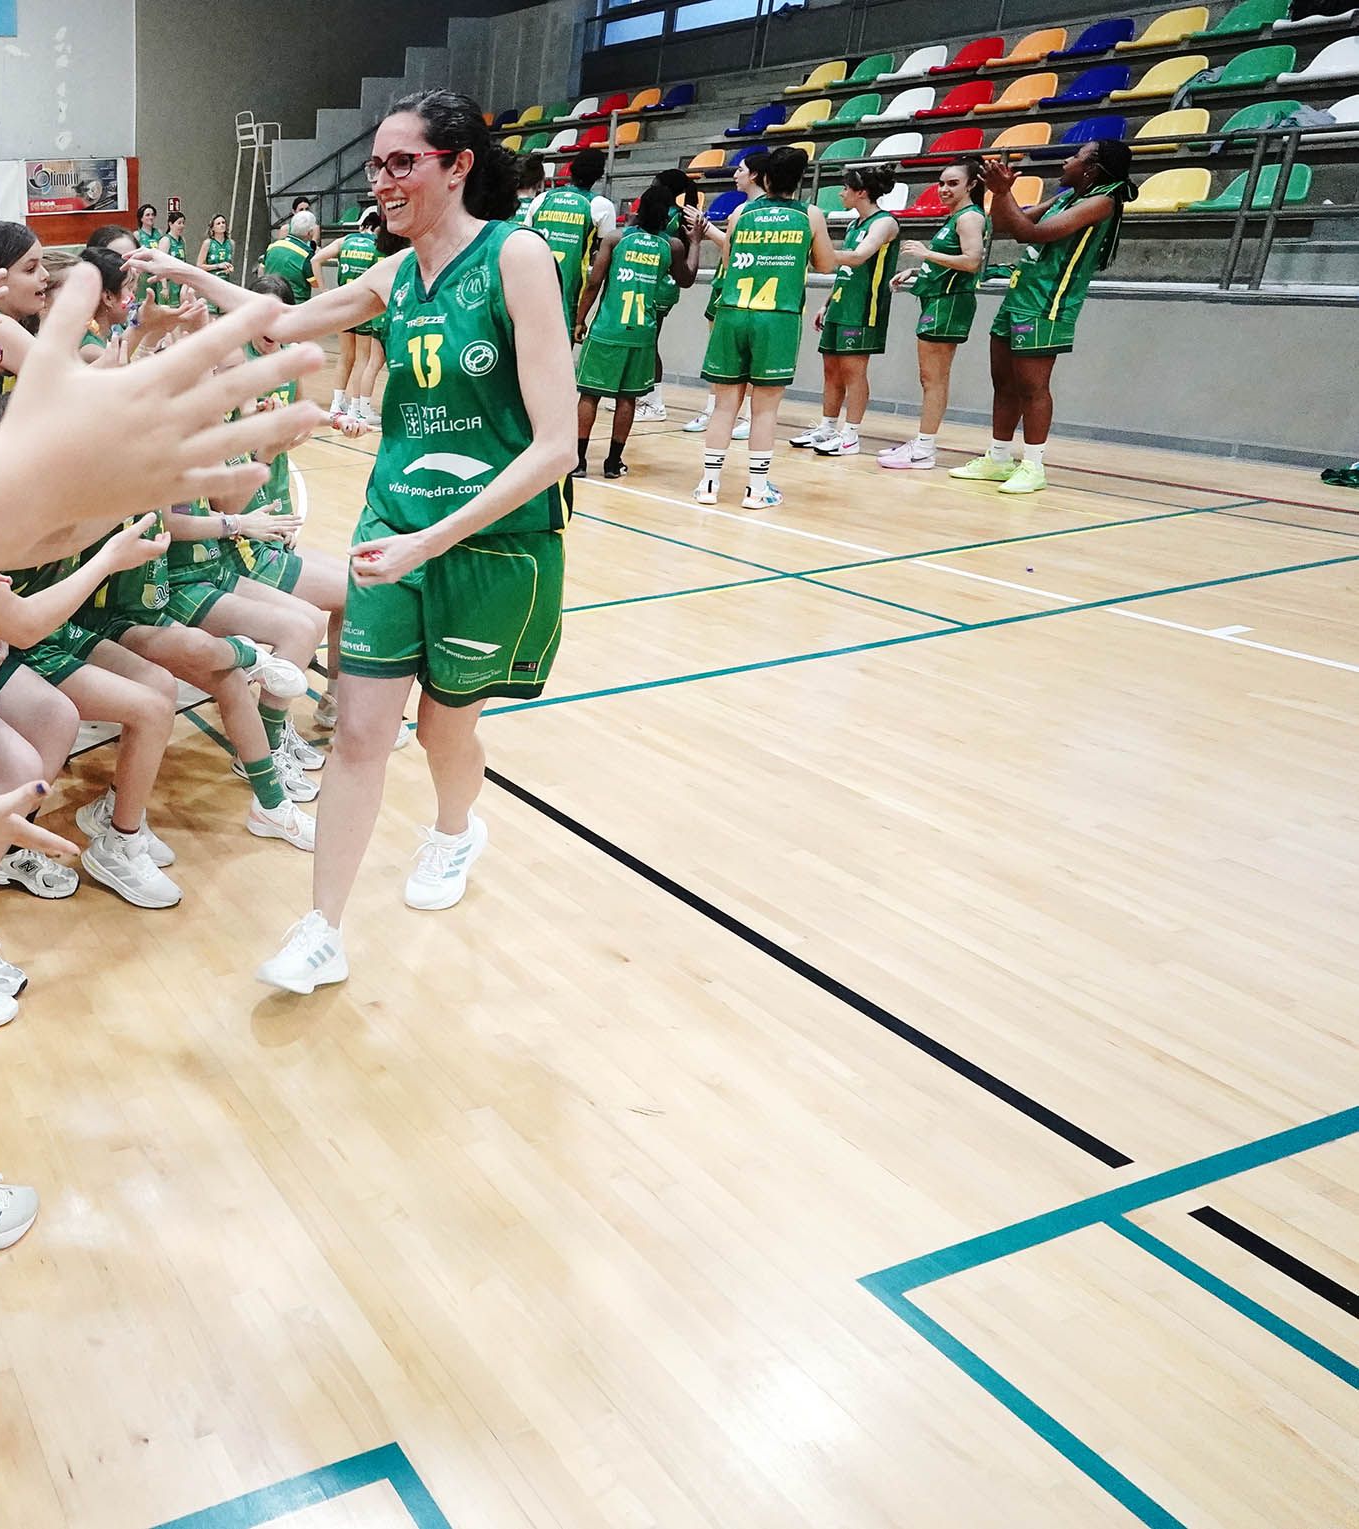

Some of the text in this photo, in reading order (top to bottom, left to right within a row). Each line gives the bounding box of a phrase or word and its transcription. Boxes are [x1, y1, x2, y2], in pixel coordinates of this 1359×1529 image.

[735, 229, 804, 244] DÍAZ-PACHE
[756, 254, 796, 262] Deputación
[736, 277, 779, 310] 14
[620, 291, 645, 325] 11
[407, 334, 443, 388] 13
[17, 860, 38, 873] N
